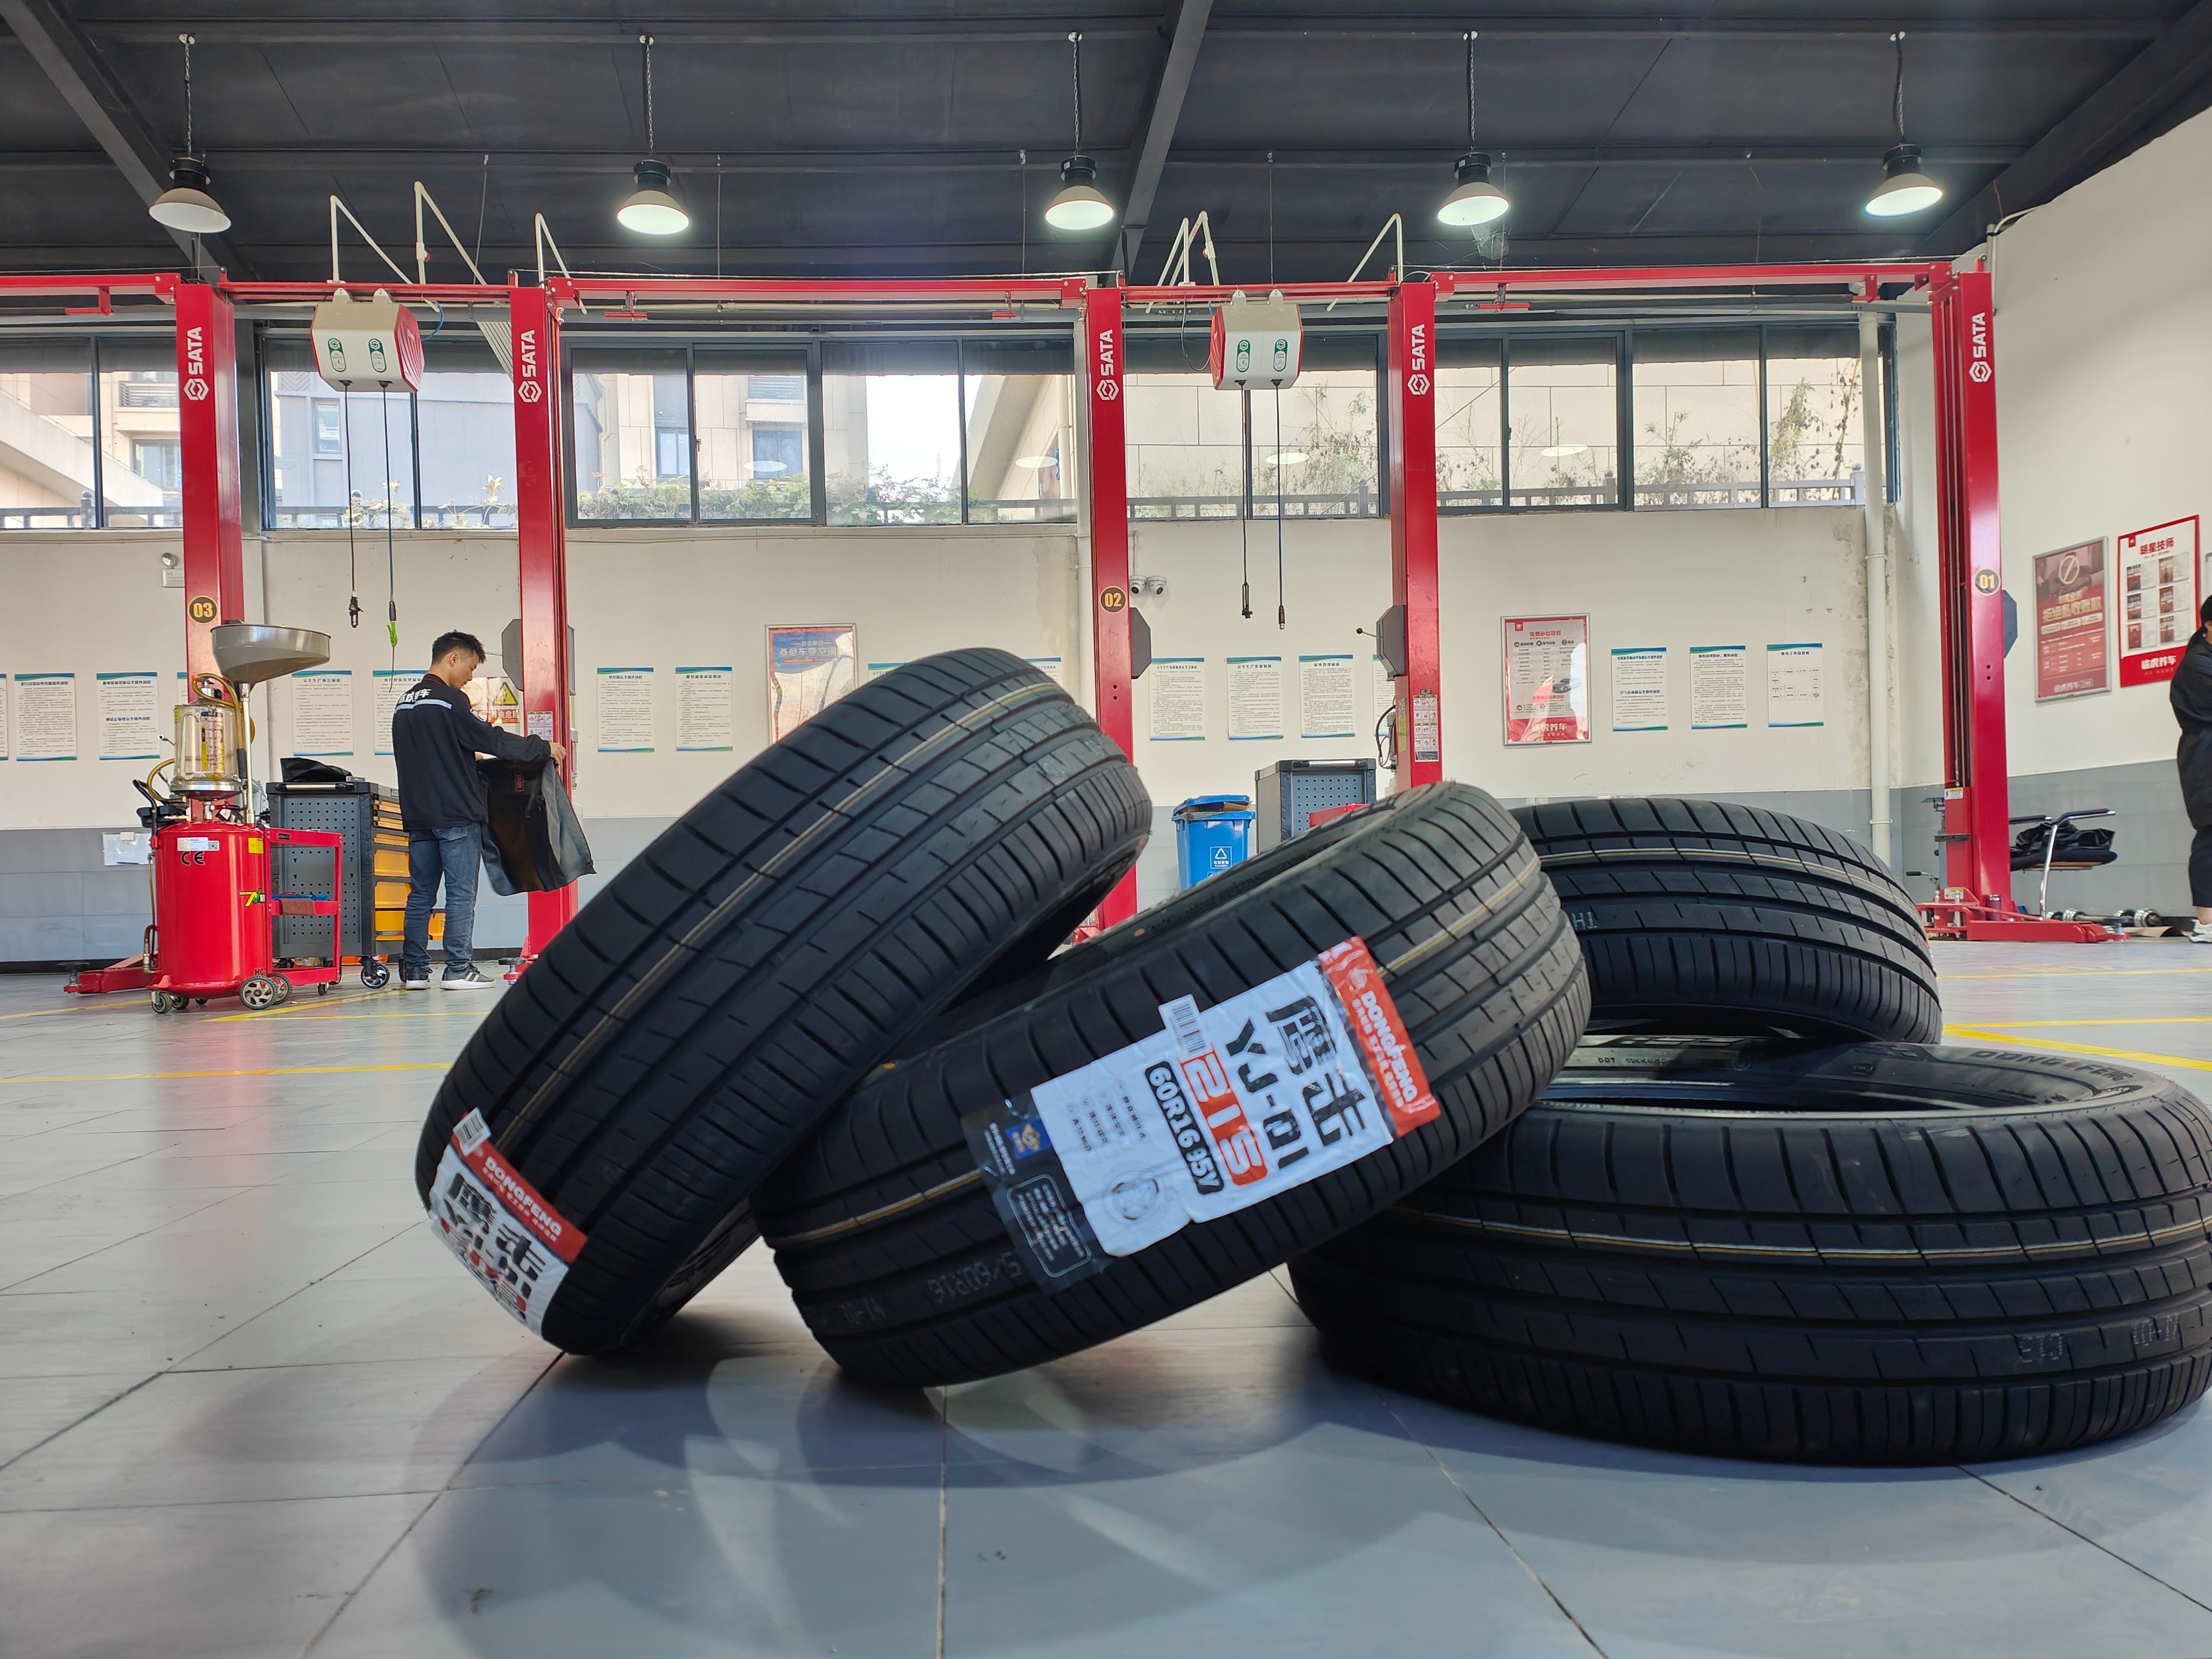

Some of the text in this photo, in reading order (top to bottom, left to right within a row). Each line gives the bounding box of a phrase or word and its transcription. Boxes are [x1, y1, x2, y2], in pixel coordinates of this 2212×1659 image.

[188, 327, 202, 375] SATA
[522, 330, 536, 377] SATA
[1100, 330, 1114, 375] SATA
[1412, 323, 1425, 370] SATA
[1972, 312, 1986, 358] SATA
[2140, 537, 2174, 555] 明星技师
[1104, 593, 1122, 607] 02
[1980, 575, 1995, 589] 01
[193, 602, 213, 618] 03
[2142, 656, 2177, 670] 途虎养车
[181, 851, 204, 865] CE
[1360, 990, 1419, 1103] DONGFENG
[1149, 1065, 1191, 1147] 60R16
[1192, 1057, 1266, 1179] 215
[485, 1157, 563, 1236] DONGFENG
